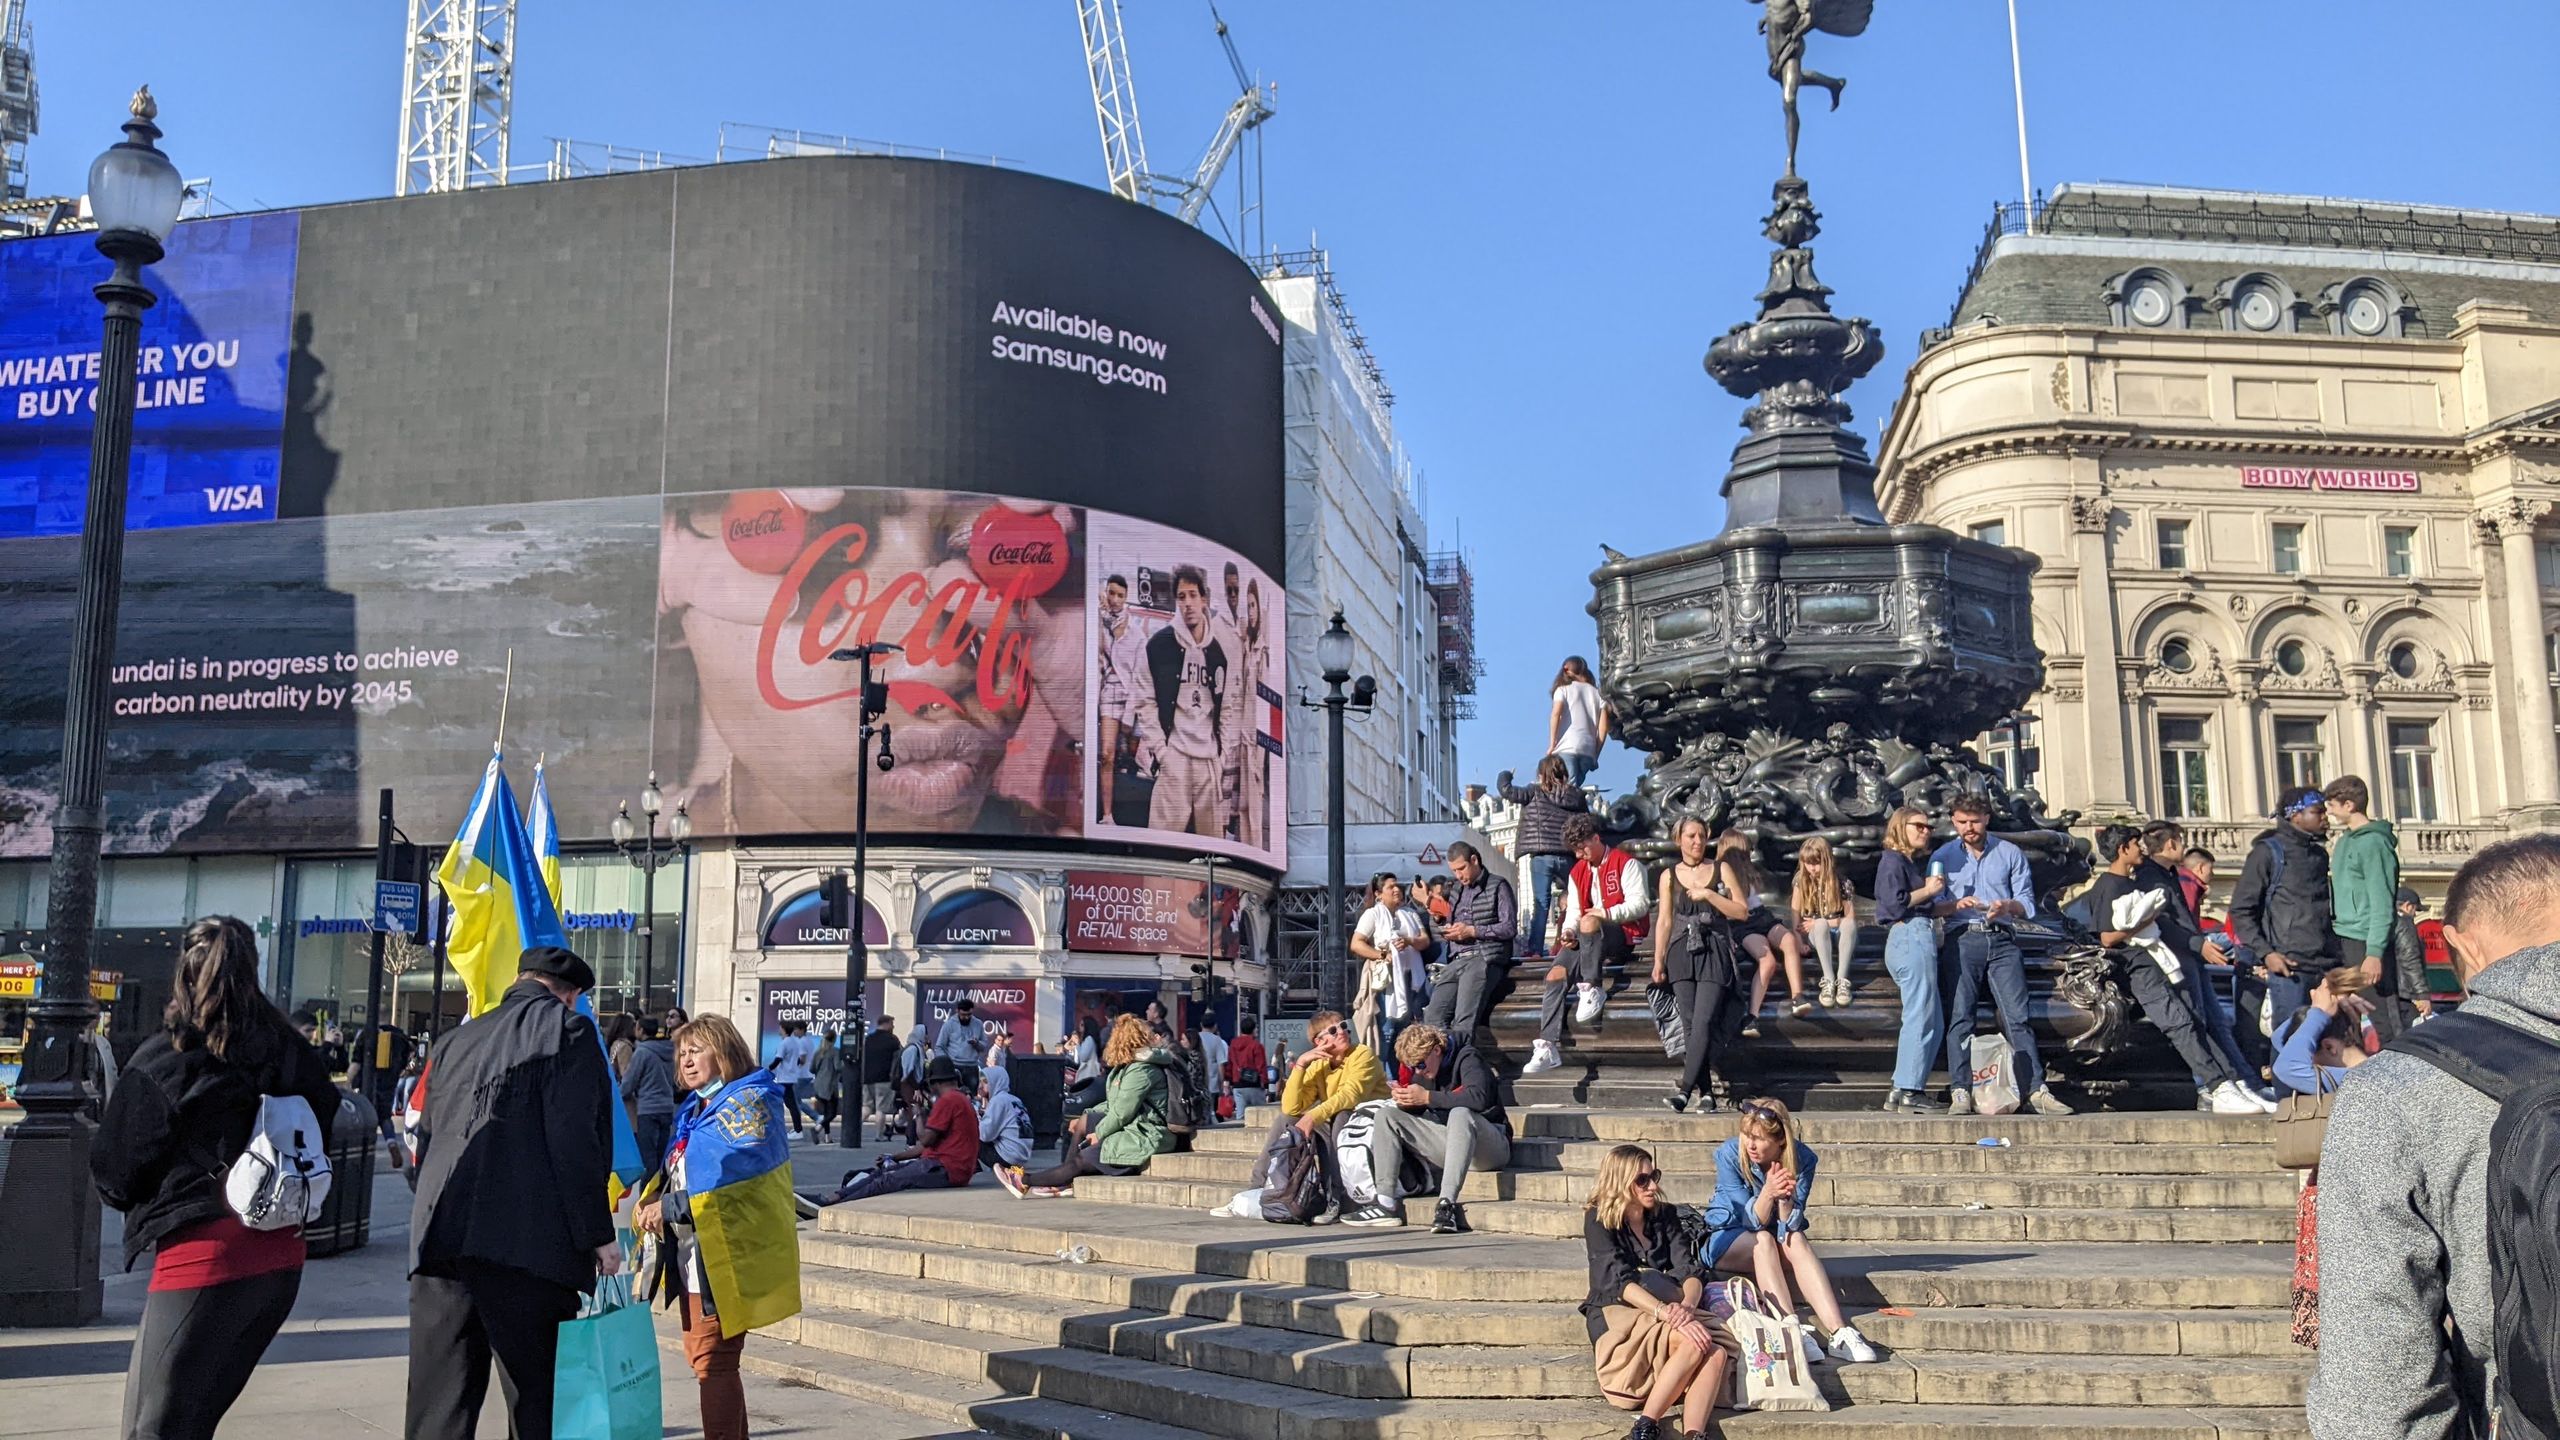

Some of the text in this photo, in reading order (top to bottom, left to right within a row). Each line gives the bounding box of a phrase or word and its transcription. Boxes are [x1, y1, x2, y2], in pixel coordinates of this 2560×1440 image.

[992, 301, 1167, 360] Available now
[0, 340, 240, 387] WHATER YOU
[992, 335, 1167, 394] Samsung.com
[18, 376, 206, 419] BUY LINE
[2241, 466, 2418, 491] BODY WORLDS
[204, 485, 264, 512] VISA
[729, 508, 785, 542] Coca-Cola
[989, 541, 1055, 566] Coca-Cola
[111, 645, 459, 683] undai is in progress to achieve
[115, 680, 411, 715] carbon neutrality by 2045
[381, 884, 416, 894] BUS LANE
[1606, 870, 1619, 896] S
[1069, 885, 1172, 905] 144,000 SQ FT
[300, 909, 637, 938] pharm beauty
[397, 912, 416, 920] BOTH
[1086, 903, 1178, 924] of OFFICE and
[798, 928, 851, 941] LUCENT
[947, 928, 999, 941] LUCENT
[1077, 921, 1168, 942] RETAIL space
[3, 966, 24, 975] HERE
[769, 990, 820, 1006] PRIME
[926, 989, 1026, 1004] ILLUMINATED
[778, 1006, 846, 1023] retail spa
[934, 1005, 952, 1022] by
[1972, 1064, 1999, 1082] SCO
